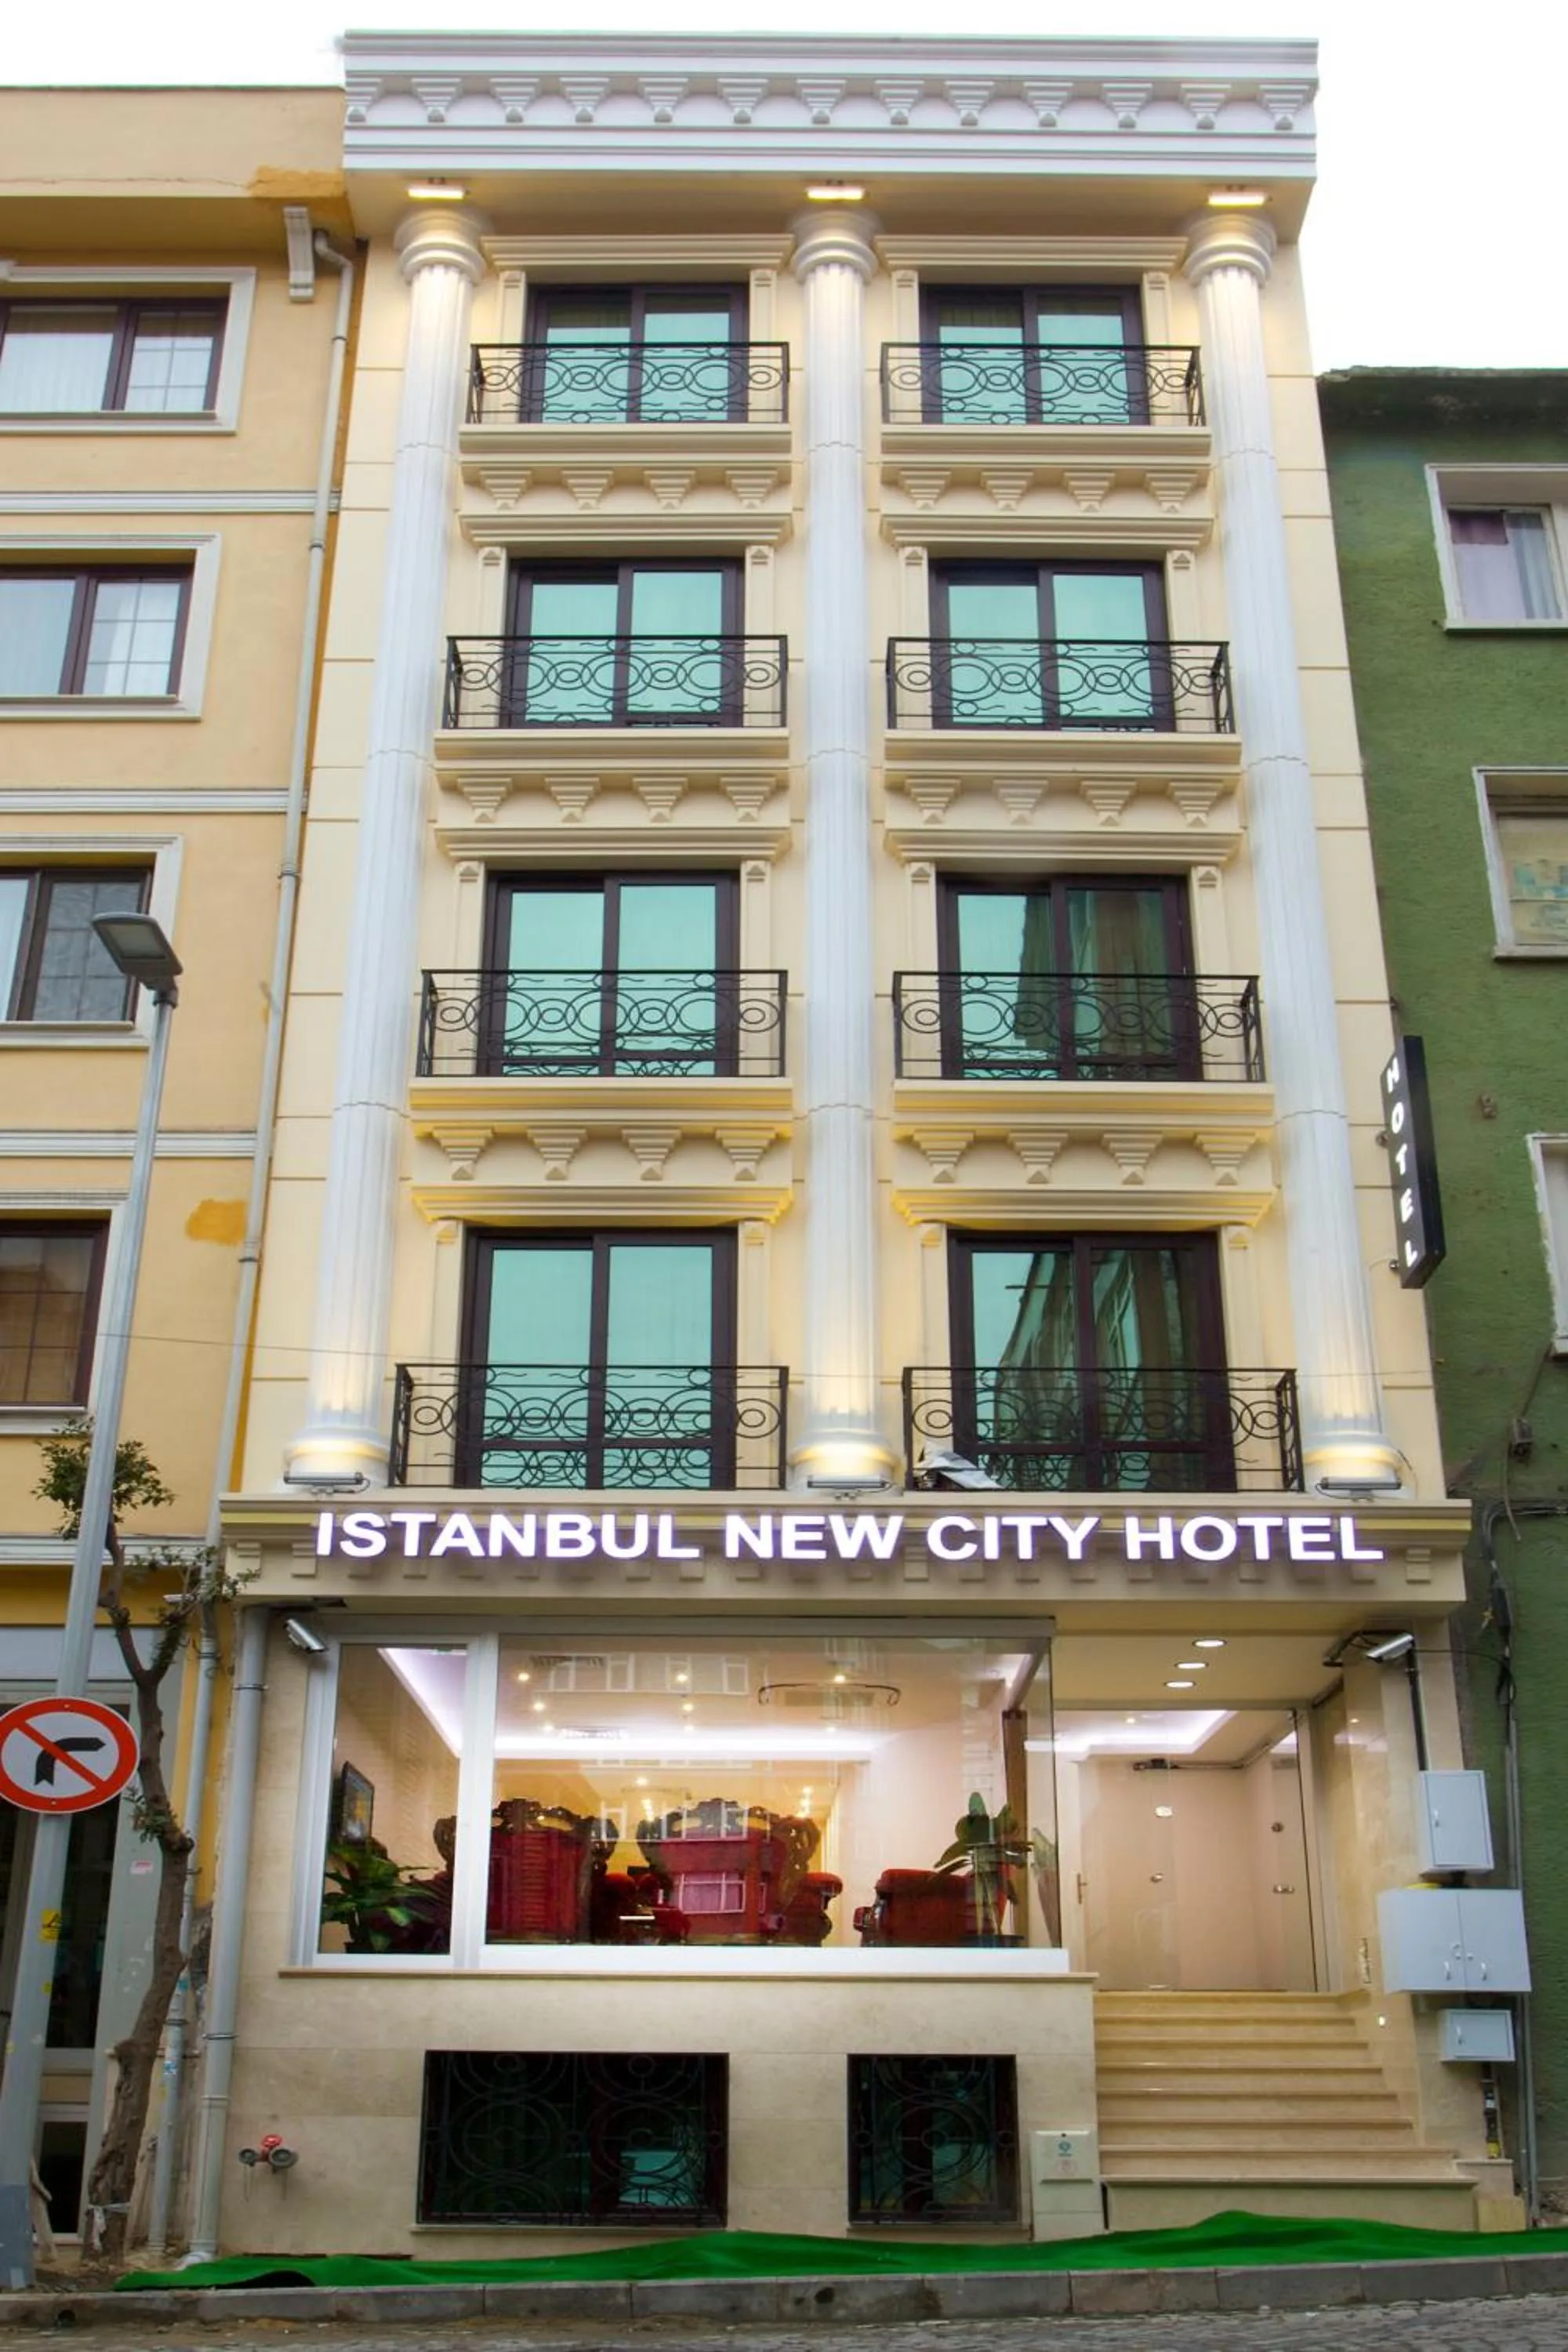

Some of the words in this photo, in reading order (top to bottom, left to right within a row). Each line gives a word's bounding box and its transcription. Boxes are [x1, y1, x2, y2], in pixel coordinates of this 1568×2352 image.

[1385, 1056, 1418, 1269] HOTEL
[315, 1512, 701, 1559] ISTANBUL
[724, 1514, 904, 1559] NEW
[926, 1515, 1100, 1561] CITY
[1124, 1515, 1385, 1561] HOTEL
